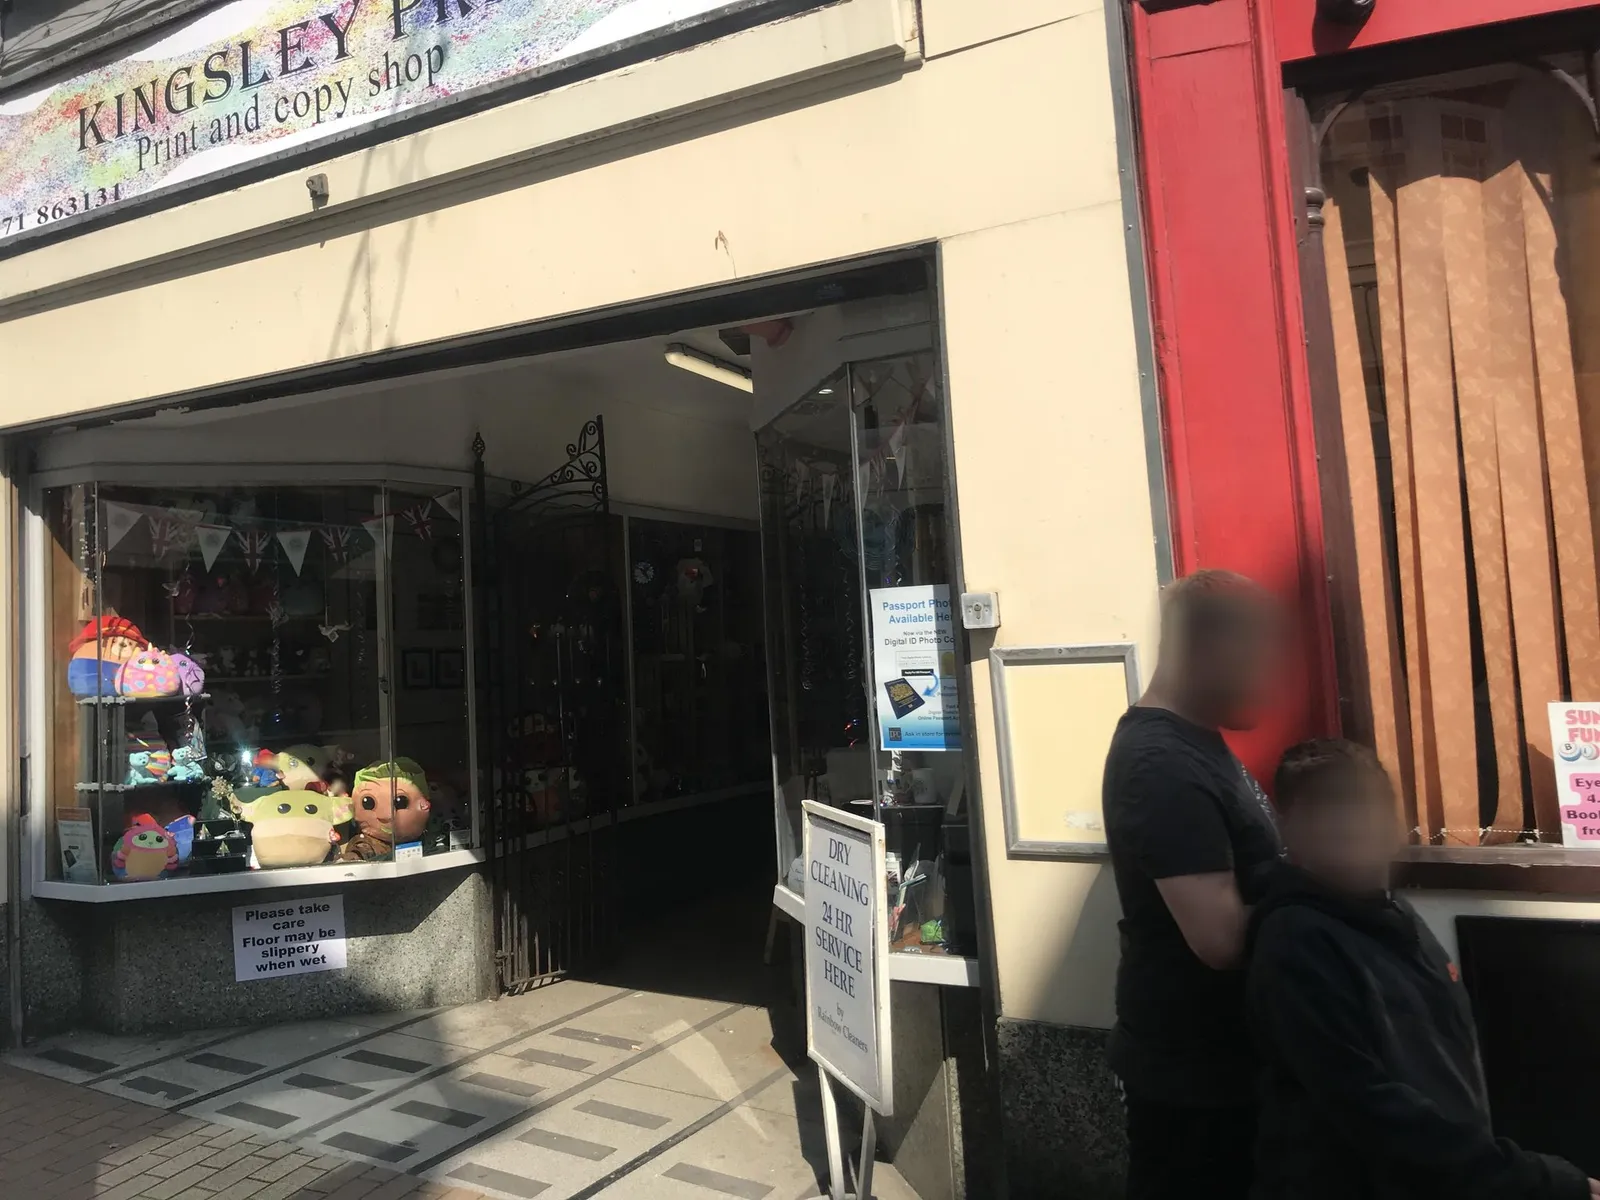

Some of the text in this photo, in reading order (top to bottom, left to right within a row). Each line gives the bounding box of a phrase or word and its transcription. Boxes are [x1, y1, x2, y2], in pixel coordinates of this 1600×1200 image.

[77, 0, 362, 151] KINGSLEY
[136, 45, 444, 171] Print and copy shop
[37, 183, 120, 224] 863131
[882, 601, 926, 611] Passport
[889, 613, 933, 624] Available
[884, 638, 907, 647] Digital
[909, 637, 917, 645] ID
[1566, 809, 1600, 820] Boo
[828, 838, 852, 866] DRY
[811, 860, 869, 906] CLEANING
[245, 903, 330, 921] Please take
[822, 901, 853, 937] 24 HR
[272, 919, 305, 931] care
[242, 928, 336, 948] Floor may be
[261, 943, 319, 958] slippery
[816, 926, 862, 974] SERVICE
[256, 954, 327, 972] when wet
[824, 959, 855, 998] HERE
[836, 1002, 844, 1021] by
[817, 1006, 868, 1053] Rainbow Cleaners
